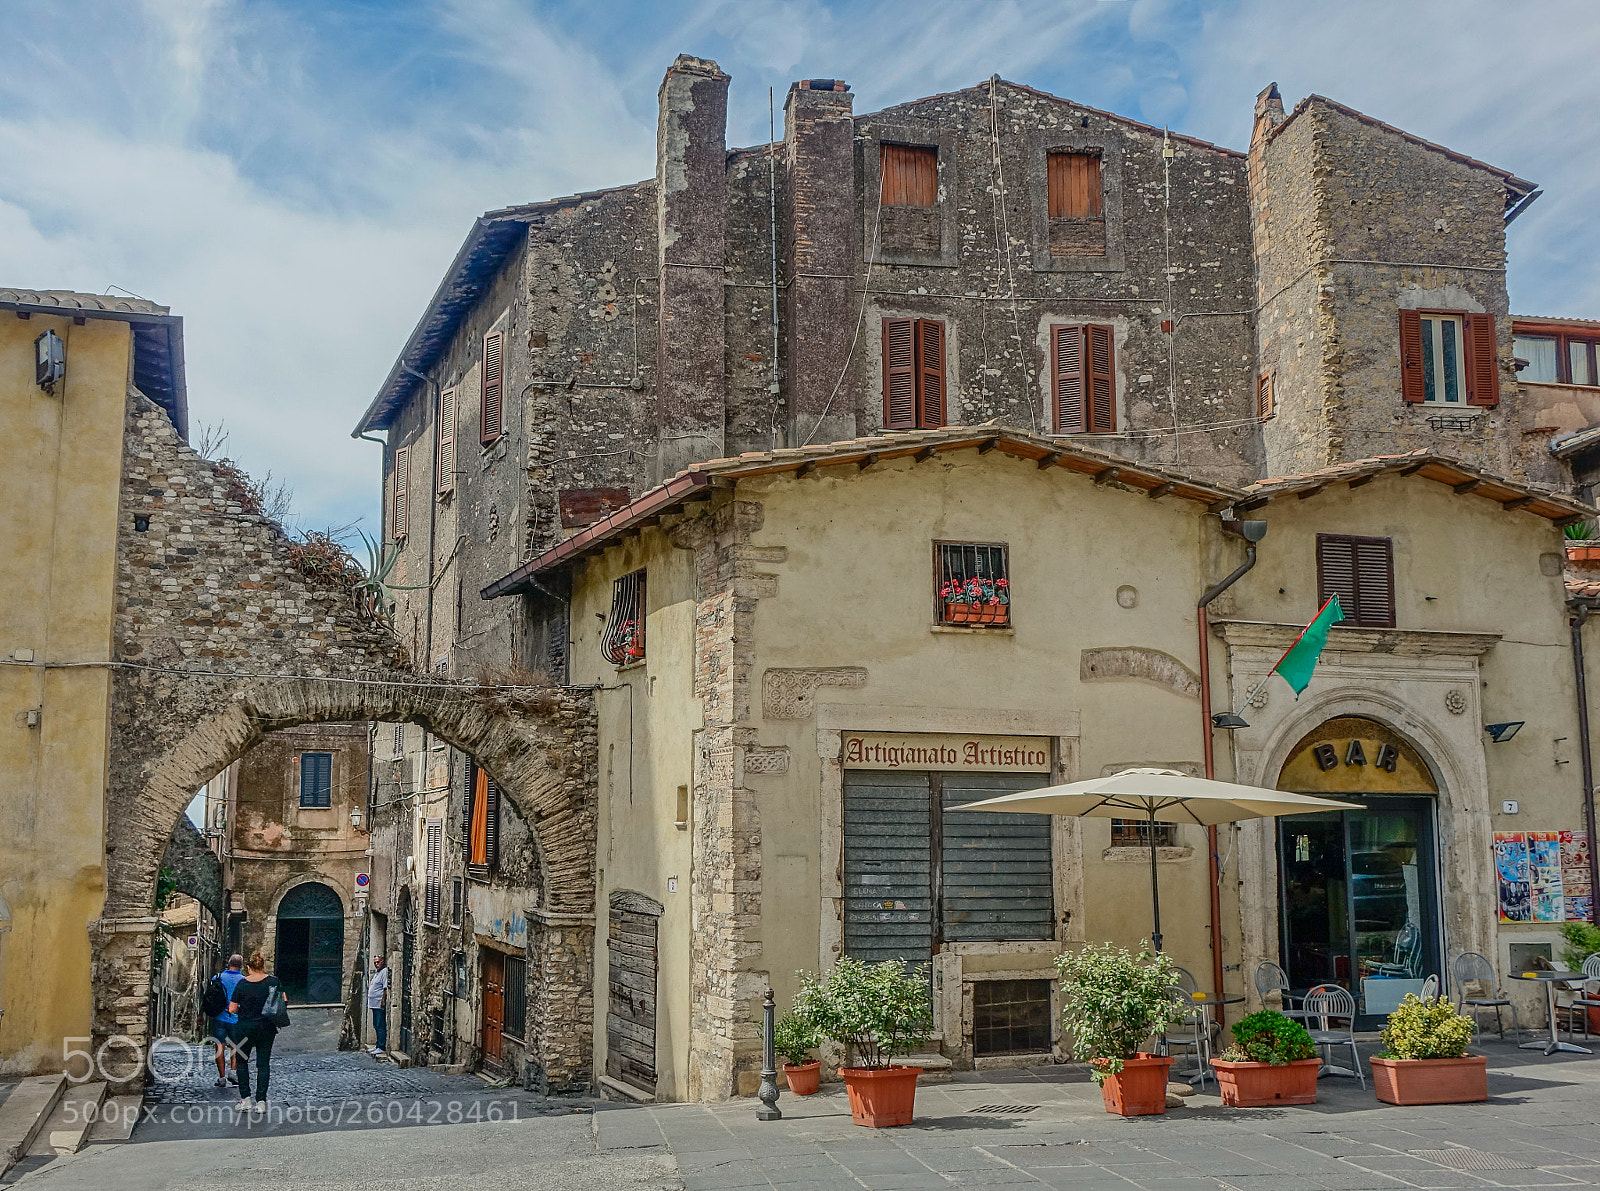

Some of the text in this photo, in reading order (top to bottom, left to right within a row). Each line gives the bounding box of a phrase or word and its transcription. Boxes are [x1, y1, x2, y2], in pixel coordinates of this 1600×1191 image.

[845, 738, 1046, 767] Artigianato Artistico
[1313, 740, 1399, 773] BAR
